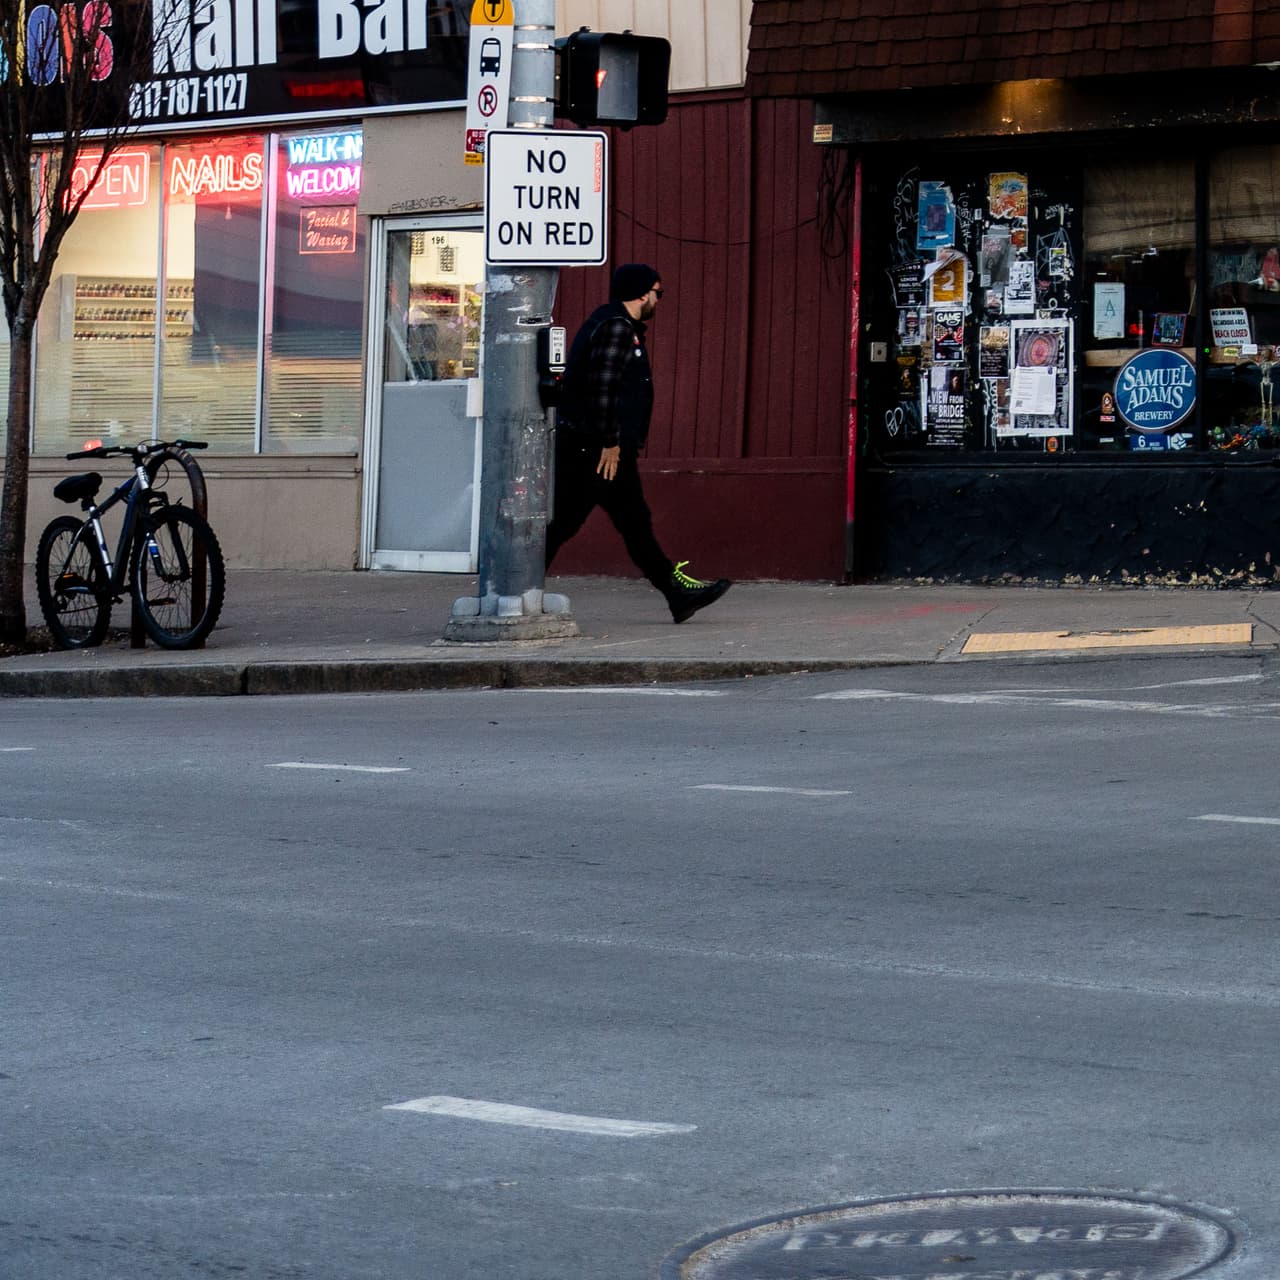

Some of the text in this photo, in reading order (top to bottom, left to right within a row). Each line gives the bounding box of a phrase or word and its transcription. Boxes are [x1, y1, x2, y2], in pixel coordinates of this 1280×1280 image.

[128, 72, 248, 119] 617-787-1127
[71, 134, 363, 200] OPEN NAILS WALK-IN
[526, 149, 567, 174] NO
[287, 165, 361, 196] WELCOM
[513, 185, 581, 210] TURN
[306, 208, 350, 231] Facial &
[306, 230, 349, 251] Waxing
[431, 235, 446, 245] 196
[498, 221, 594, 246] ON RED
[942, 270, 955, 291] 2
[1104, 299, 1116, 317] A
[1123, 365, 1193, 392] SAMUEL
[931, 391, 949, 404] VIEW
[949, 395, 964, 404] FROM
[1125, 386, 1183, 414] ADAMS
[938, 404, 965, 418] BRIDGE
[1134, 410, 1174, 422] BREWERY
[1137, 435, 1146, 448] 6
